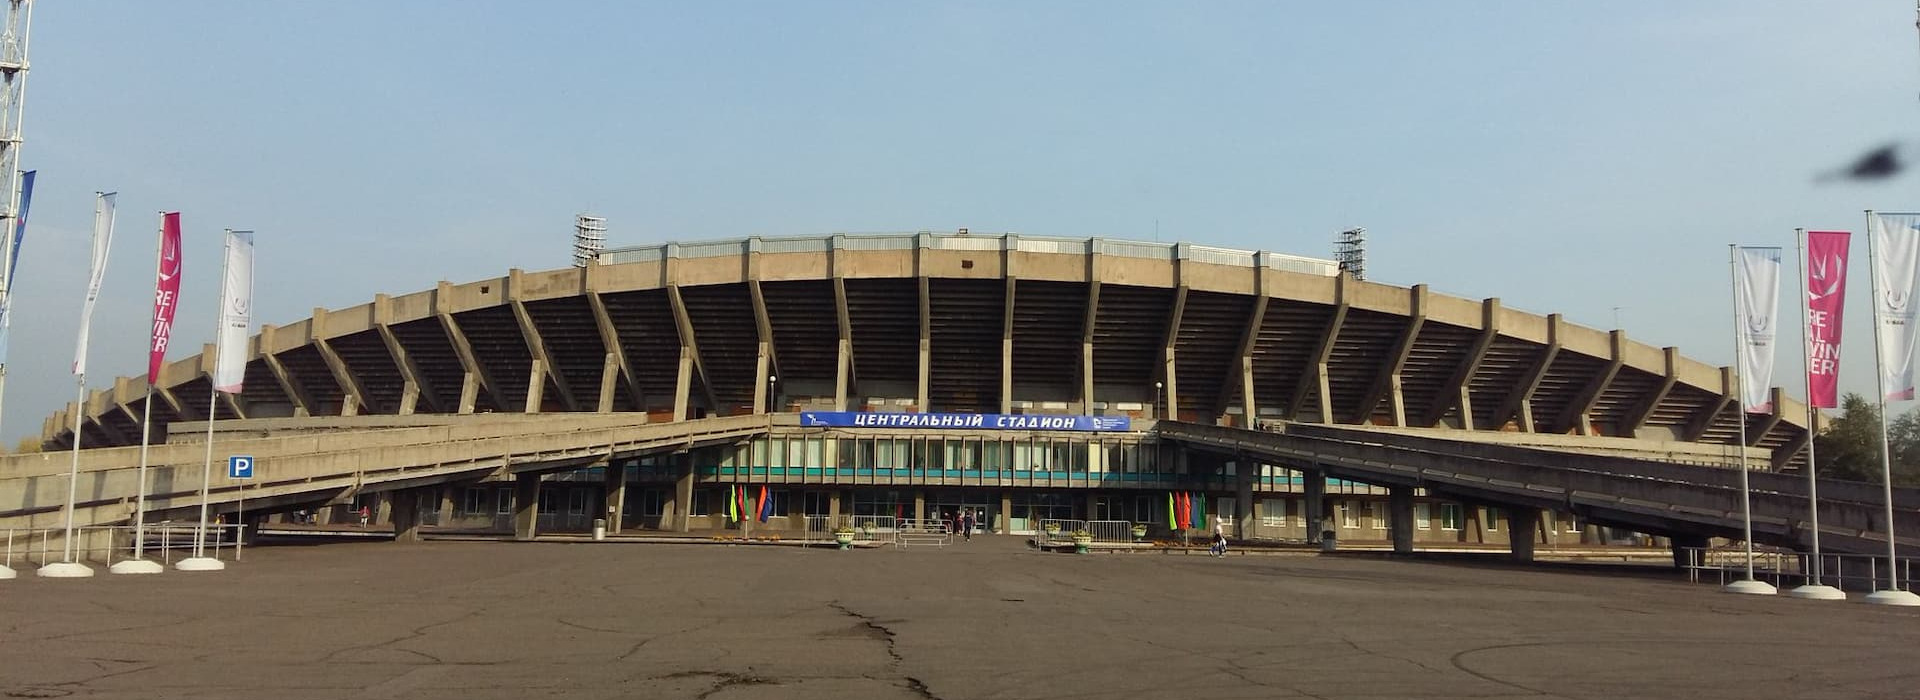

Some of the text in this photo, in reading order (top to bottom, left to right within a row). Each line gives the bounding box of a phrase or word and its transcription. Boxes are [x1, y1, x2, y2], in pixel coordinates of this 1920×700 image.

[153, 335, 168, 353] R
[1810, 357, 1835, 375] ER
[854, 413, 1076, 429] ЦЕНТРАЛЬНЫЙ СТАДИОН
[235, 459, 250, 477] P
